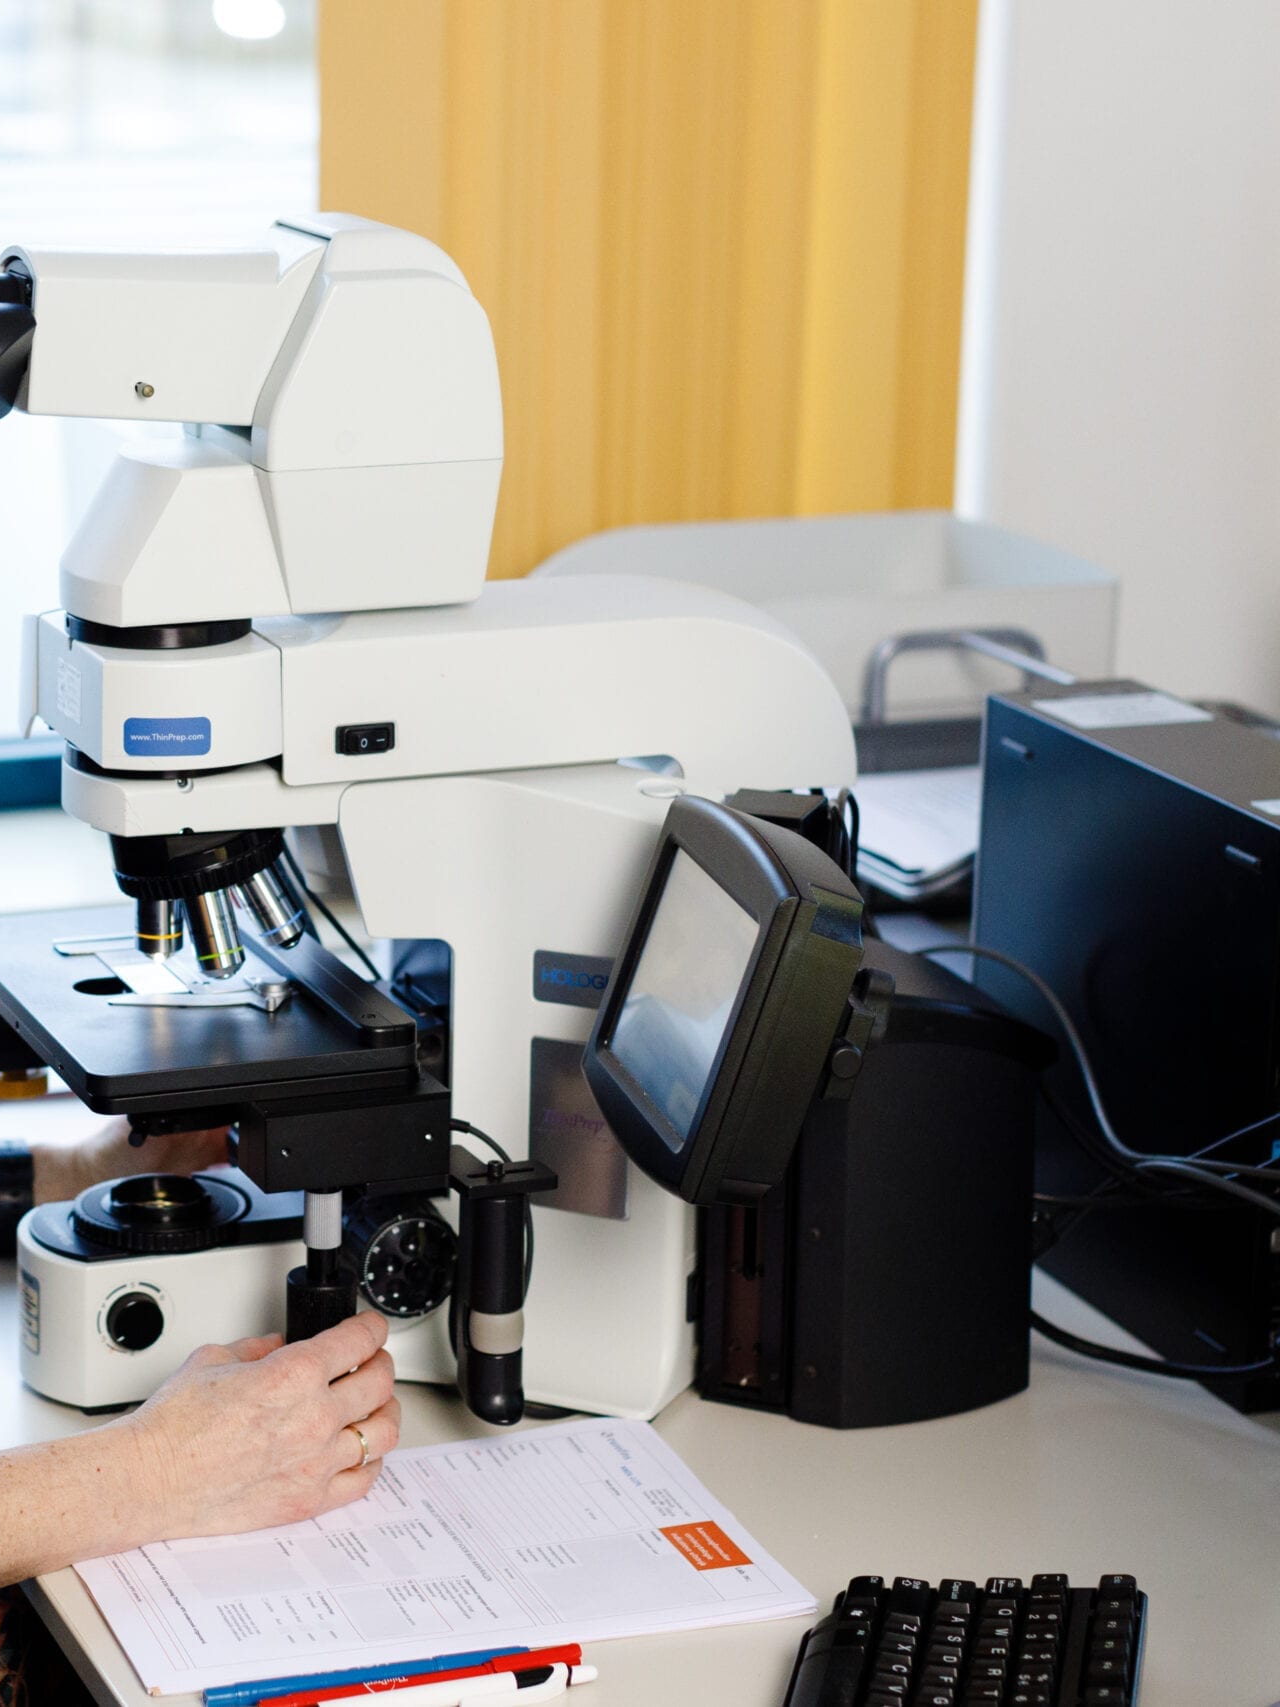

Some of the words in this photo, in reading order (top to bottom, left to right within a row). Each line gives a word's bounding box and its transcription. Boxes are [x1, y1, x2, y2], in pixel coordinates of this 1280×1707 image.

[130, 733, 204, 742] www.ThinPrep.com
[998, 1608, 1013, 1616] Q
[951, 1615, 965, 1623] A
[902, 1623, 917, 1633] Z
[994, 1628, 1009, 1637] W
[947, 1635, 961, 1643] S
[897, 1643, 912, 1652] X
[991, 1647, 1006, 1655] E
[942, 1655, 957, 1663] D
[892, 1664, 907, 1673] C
[987, 1668, 1002, 1676] R
[939, 1675, 953, 1683] F
[888, 1685, 903, 1694] V
[933, 1696, 949, 1705] G
